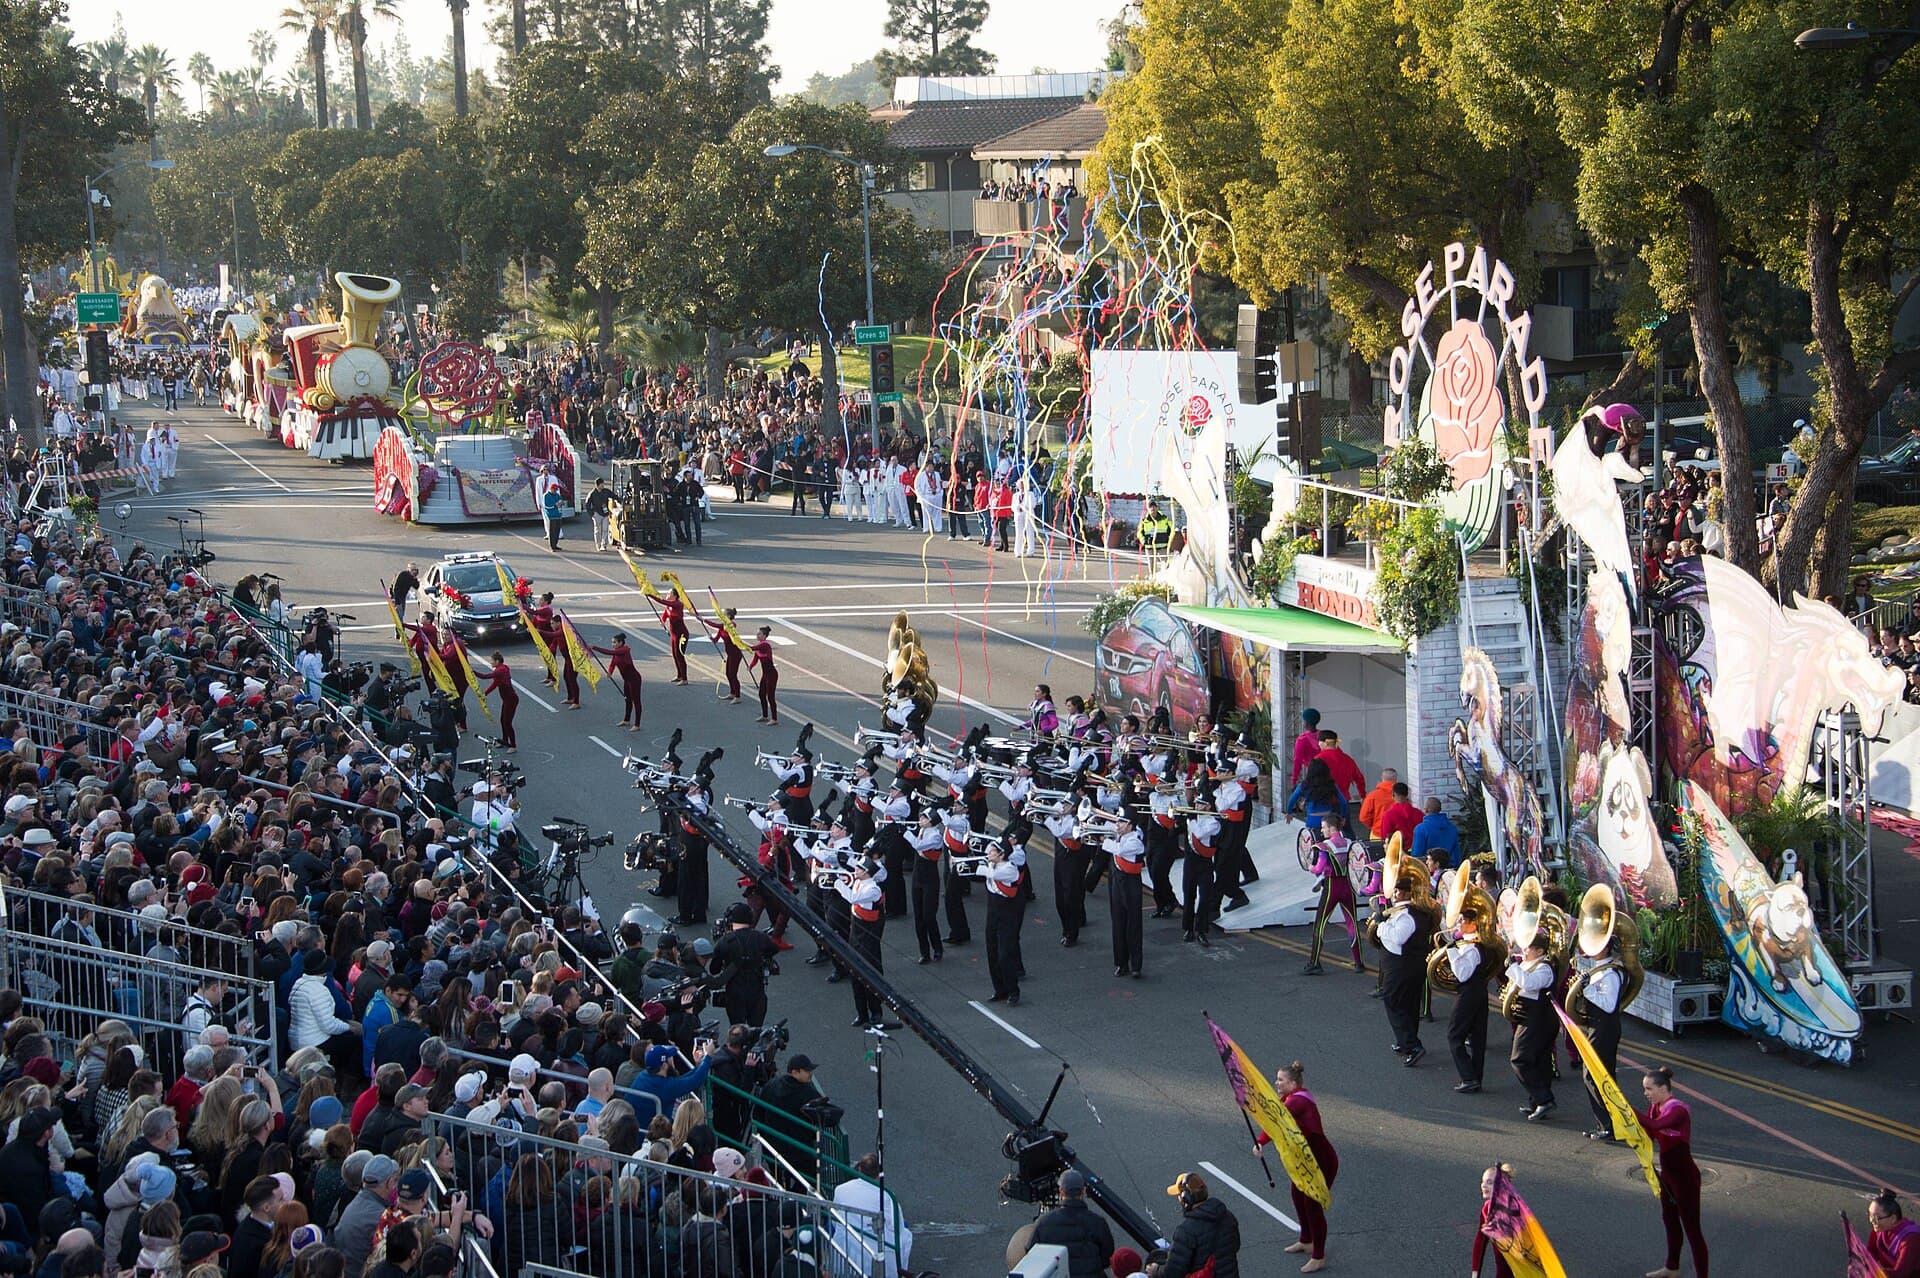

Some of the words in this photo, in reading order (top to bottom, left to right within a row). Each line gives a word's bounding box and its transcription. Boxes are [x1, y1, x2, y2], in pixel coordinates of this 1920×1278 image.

[1383, 259, 1440, 449] ROSE
[1443, 242, 1555, 473] PARADE
[1158, 380, 1183, 428] ROSE
[1191, 376, 1236, 428] PARADE
[1775, 464, 1787, 477] 15
[1297, 581, 1380, 629] HONDA
